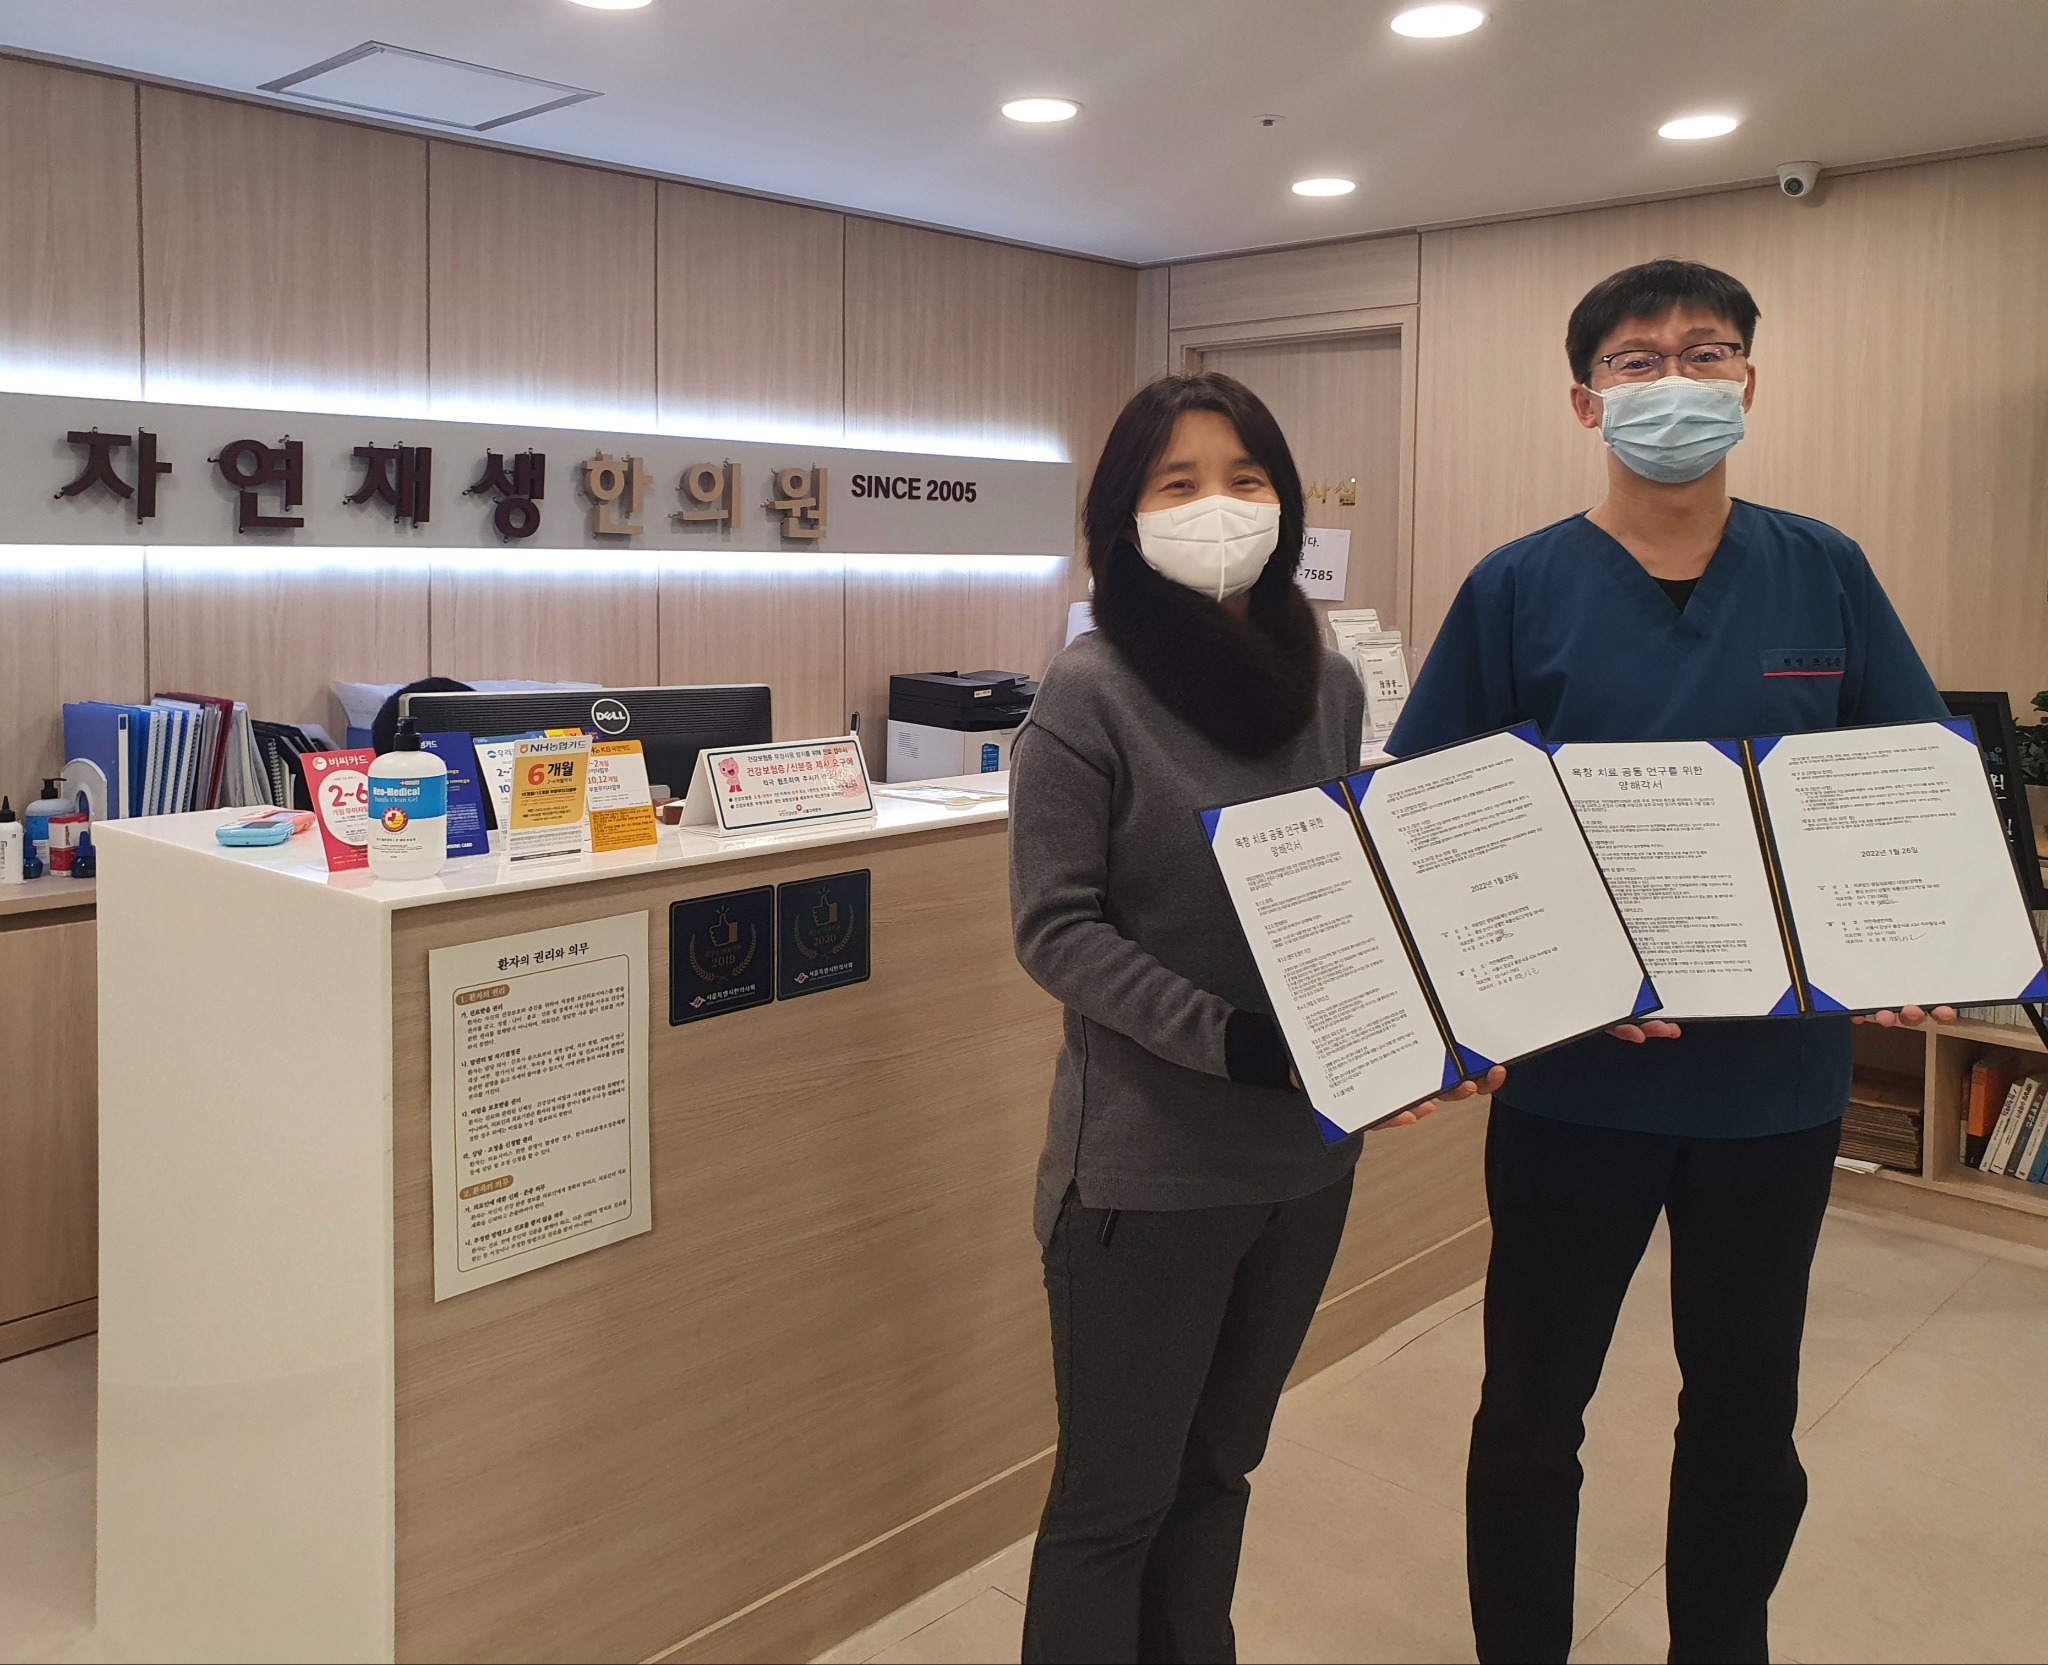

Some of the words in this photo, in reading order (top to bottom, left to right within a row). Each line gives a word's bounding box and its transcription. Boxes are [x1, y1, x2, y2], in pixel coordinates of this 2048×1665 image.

[851, 473, 921, 500] SINCE
[926, 479, 977, 503] 2005
[1306, 480, 1356, 507] 사실
[595, 710, 626, 721] DELL
[329, 755, 369, 767] 비씨카드
[748, 754, 772, 762] 건강보험증
[547, 761, 574, 777] 개월
[1572, 768, 1592, 778] 욕창
[1598, 768, 1618, 777] 치료
[1621, 767, 1642, 777] 공동
[1646, 766, 1678, 776] 연구를
[1682, 765, 1702, 776] 위한
[1618, 780, 1663, 790] 양해각서
[373, 787, 420, 796] Neo-Medical
[1235, 836, 1250, 848] 욕창
[1252, 832, 1268, 844] 치료
[1268, 828, 1284, 841] 공동
[1285, 821, 1308, 836] 연구를
[1309, 817, 1324, 829] 위한
[1270, 839, 1302, 857] 양해각서
[1861, 849, 1886, 858] 2022년
[1888, 848, 1900, 856] 1월
[1470, 881, 1493, 892] 2022년
[1494, 877, 1504, 885] 1월
[1504, 872, 1519, 882] 26일
[813, 934, 836, 946] 2020
[497, 953, 529, 971] 환자의
[533, 946, 565, 964] 권리와
[568, 941, 590, 957] 의무
[712, 955, 735, 967] 2019
